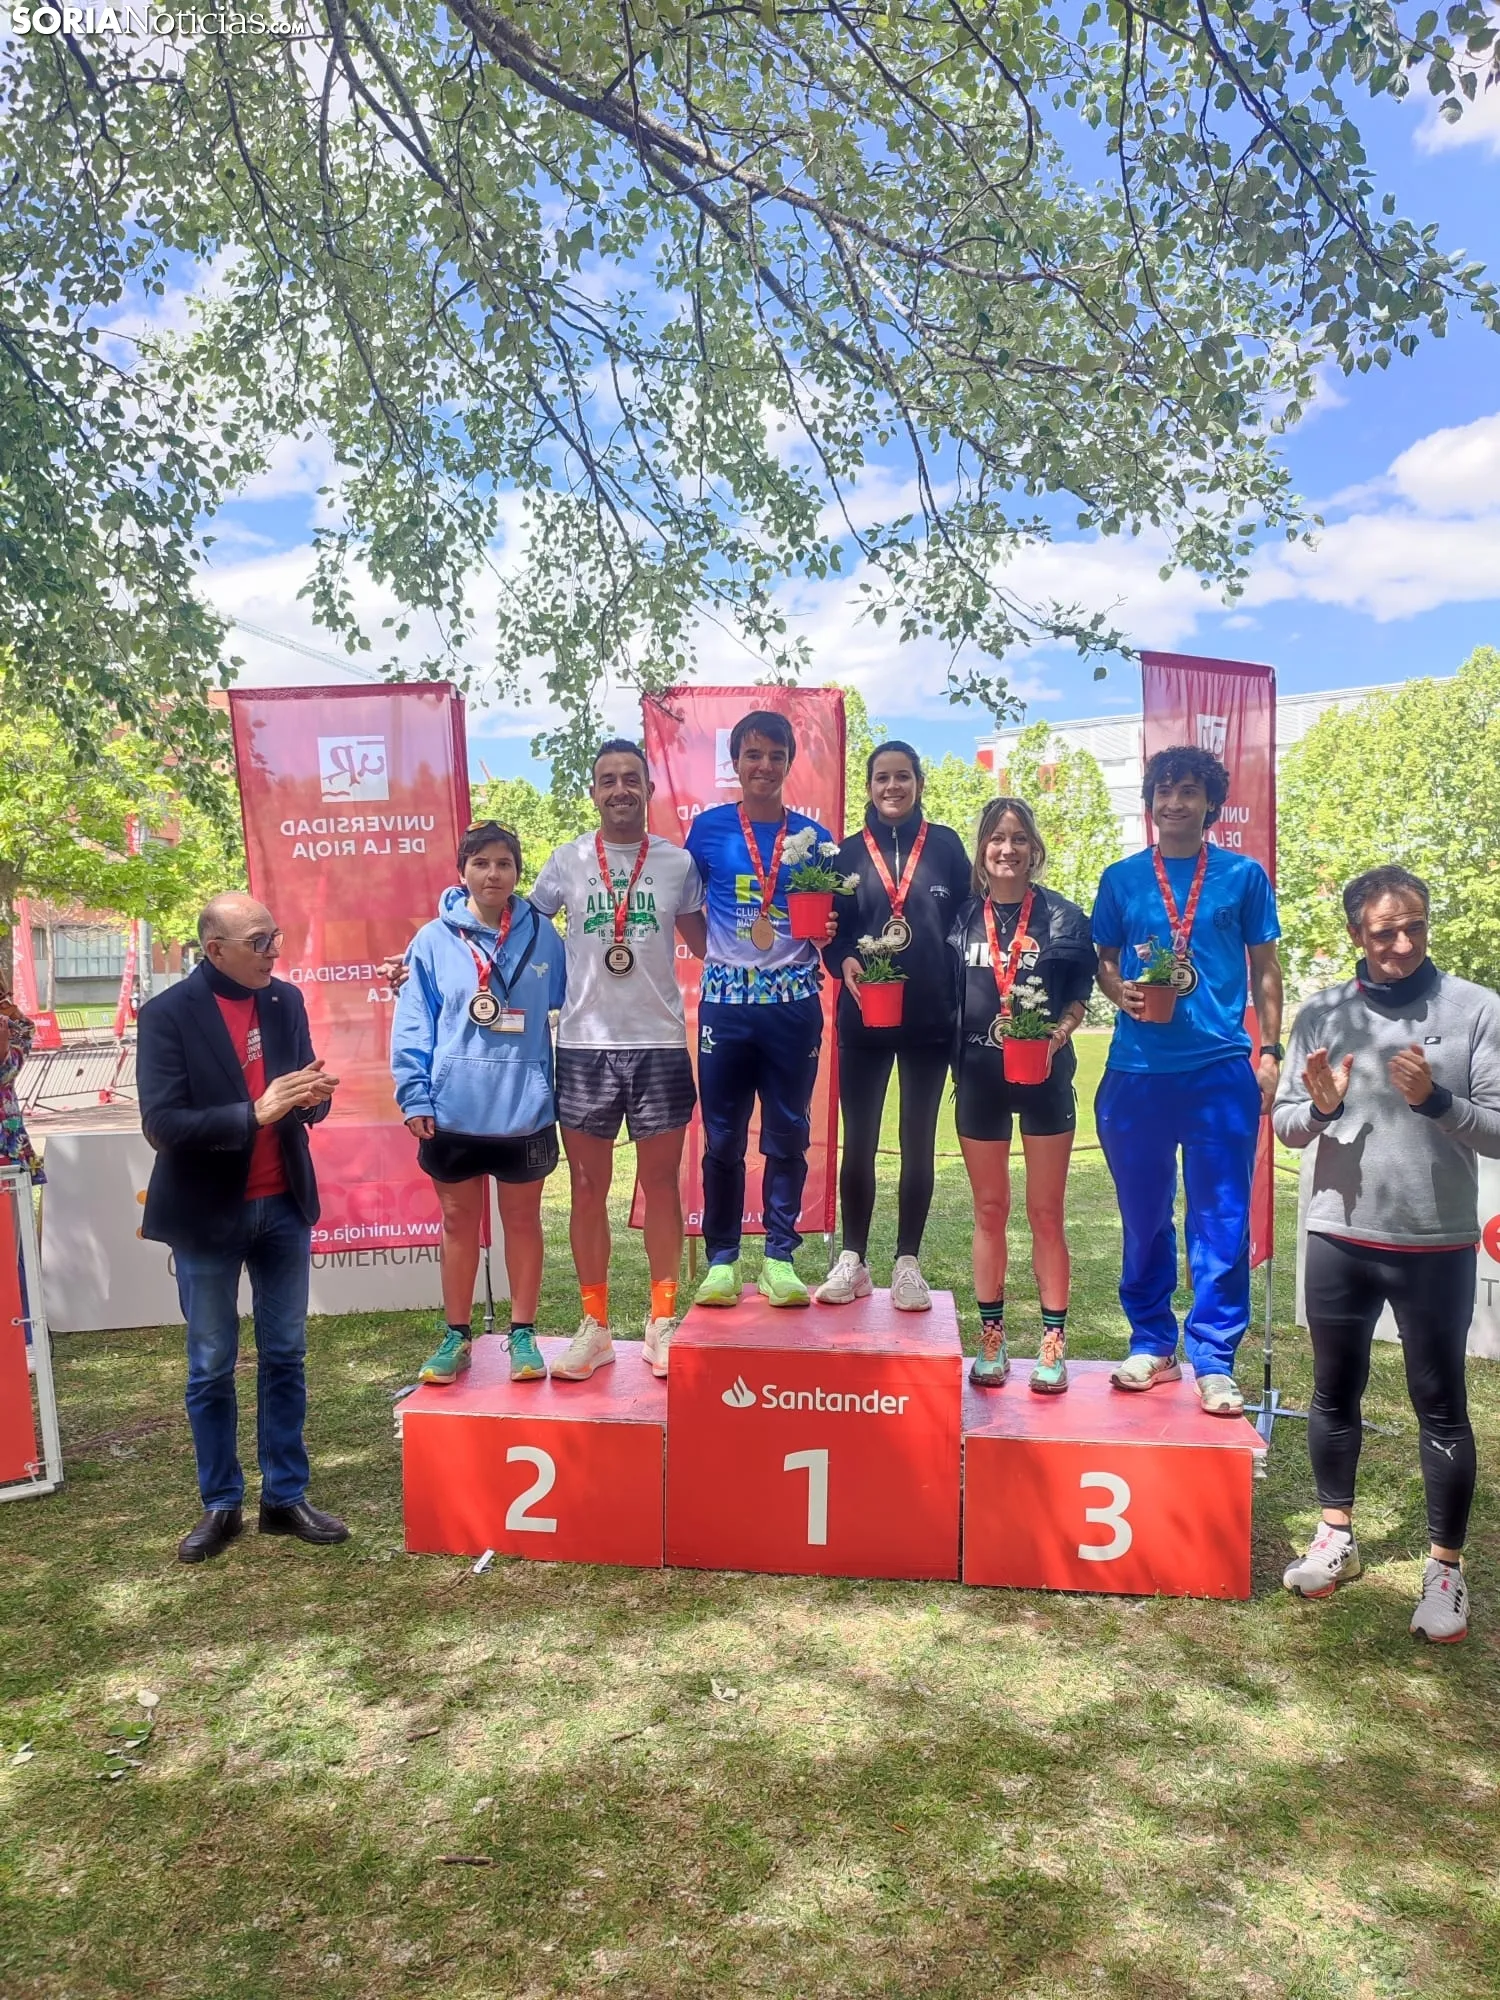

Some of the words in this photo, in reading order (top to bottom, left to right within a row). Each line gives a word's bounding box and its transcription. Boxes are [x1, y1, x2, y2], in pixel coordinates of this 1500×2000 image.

[761, 1383, 909, 1415] Santander
[504, 1445, 558, 1533] 2
[782, 1448, 829, 1546] 1
[1077, 1471, 1133, 1562] 3
